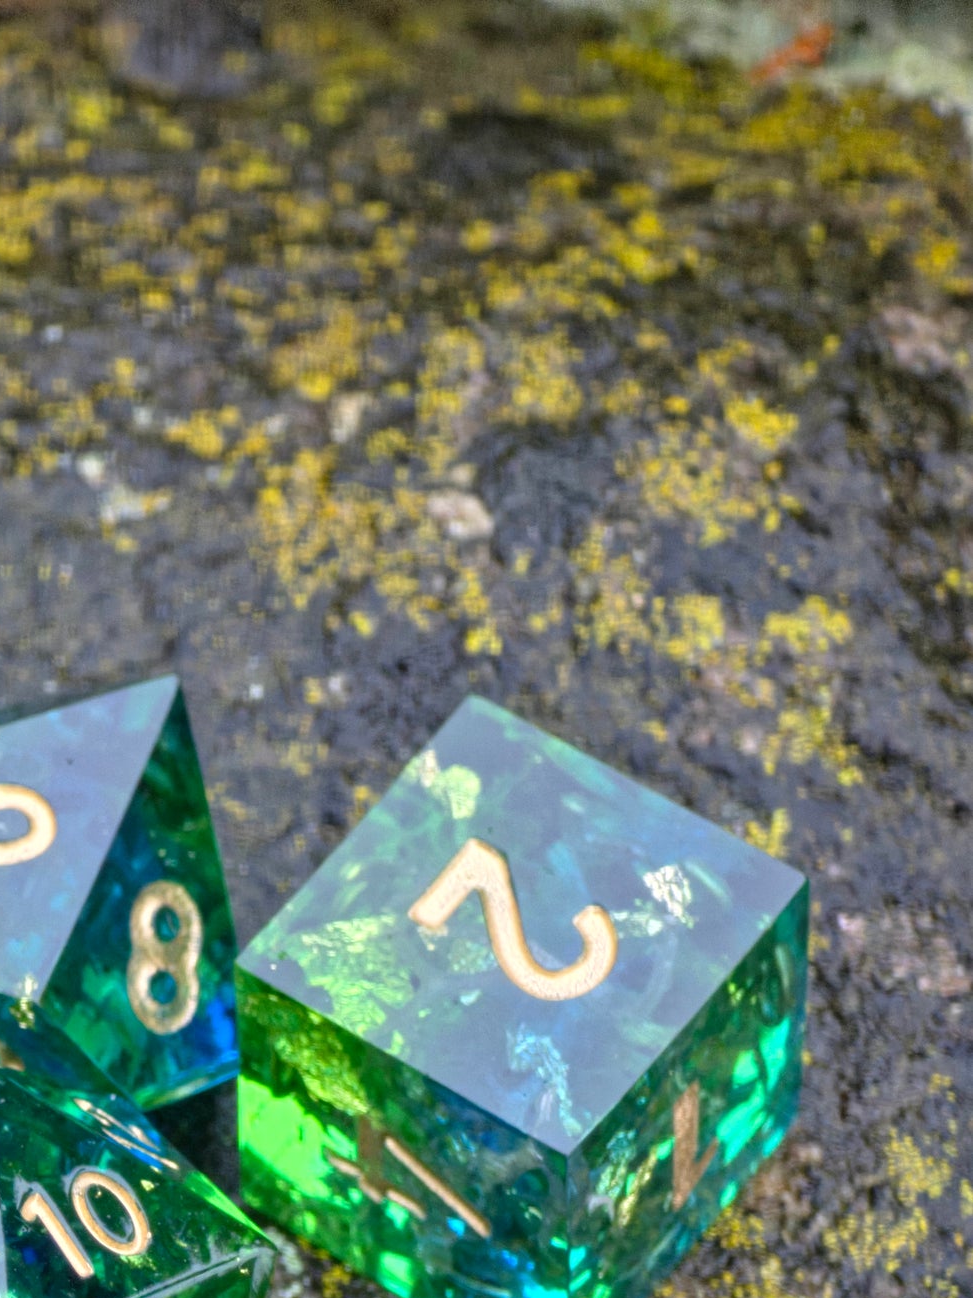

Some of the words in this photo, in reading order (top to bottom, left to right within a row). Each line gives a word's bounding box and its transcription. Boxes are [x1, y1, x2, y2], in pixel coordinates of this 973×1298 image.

[128, 880, 203, 1035] 8
[408, 838, 617, 1001] 2
[20, 1169, 152, 1279] 10
